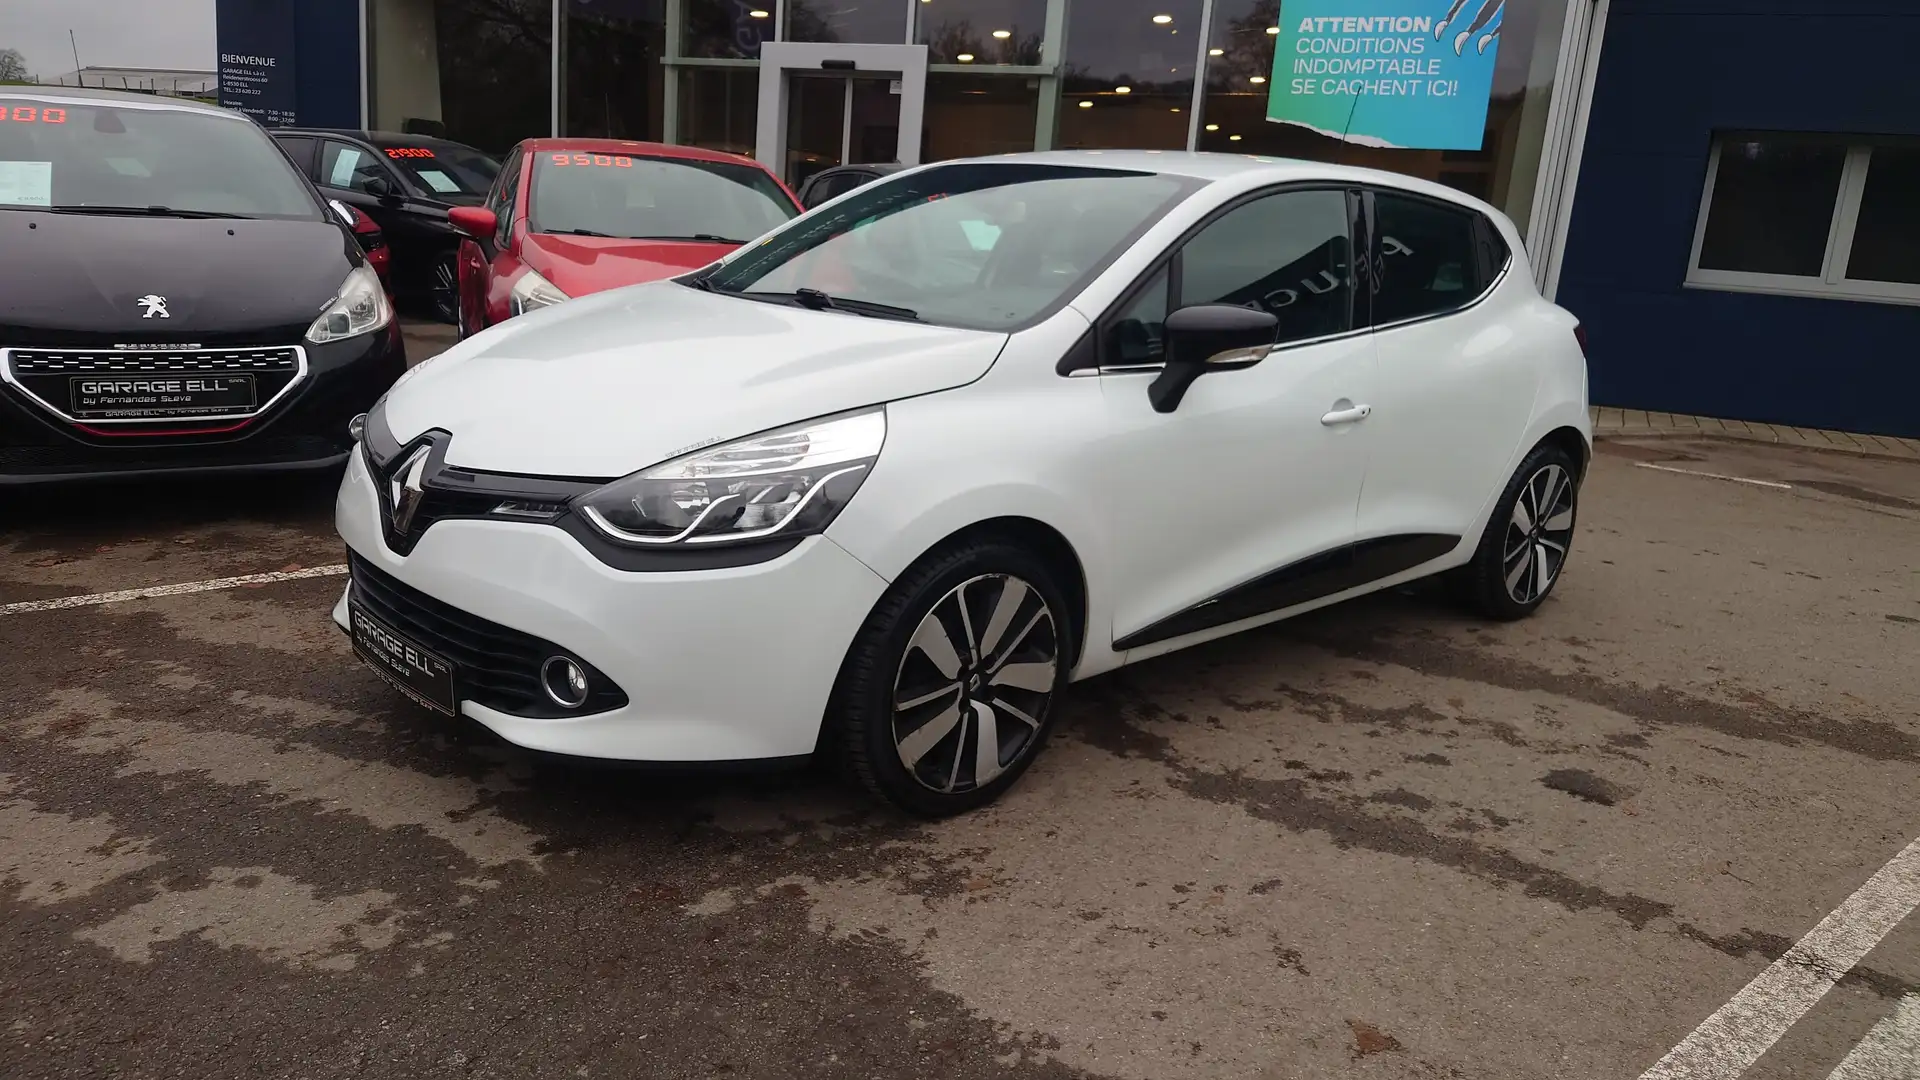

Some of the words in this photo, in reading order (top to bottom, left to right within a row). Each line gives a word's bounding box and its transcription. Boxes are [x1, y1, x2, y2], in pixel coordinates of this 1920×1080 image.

[1298, 16, 1432, 33] ATTENTION
[1295, 37, 1425, 54] CONDITIONS
[221, 53, 276, 67] BIENVENUE
[1293, 58, 1441, 75] INDOMPTABLE
[1290, 78, 1316, 95] SE
[1321, 78, 1422, 96] CACHENT
[1427, 79, 1458, 97] ICI!
[384, 148, 435, 159] 21900
[552, 154, 633, 167] 9500
[81, 381, 181, 394] GARAGE
[186, 380, 229, 392] ELL
[83, 396, 96, 405] by
[100, 395, 157, 404] Fernandes
[161, 394, 192, 403] Steve
[354, 610, 403, 659] GARAGE
[405, 646, 435, 678] ELL
